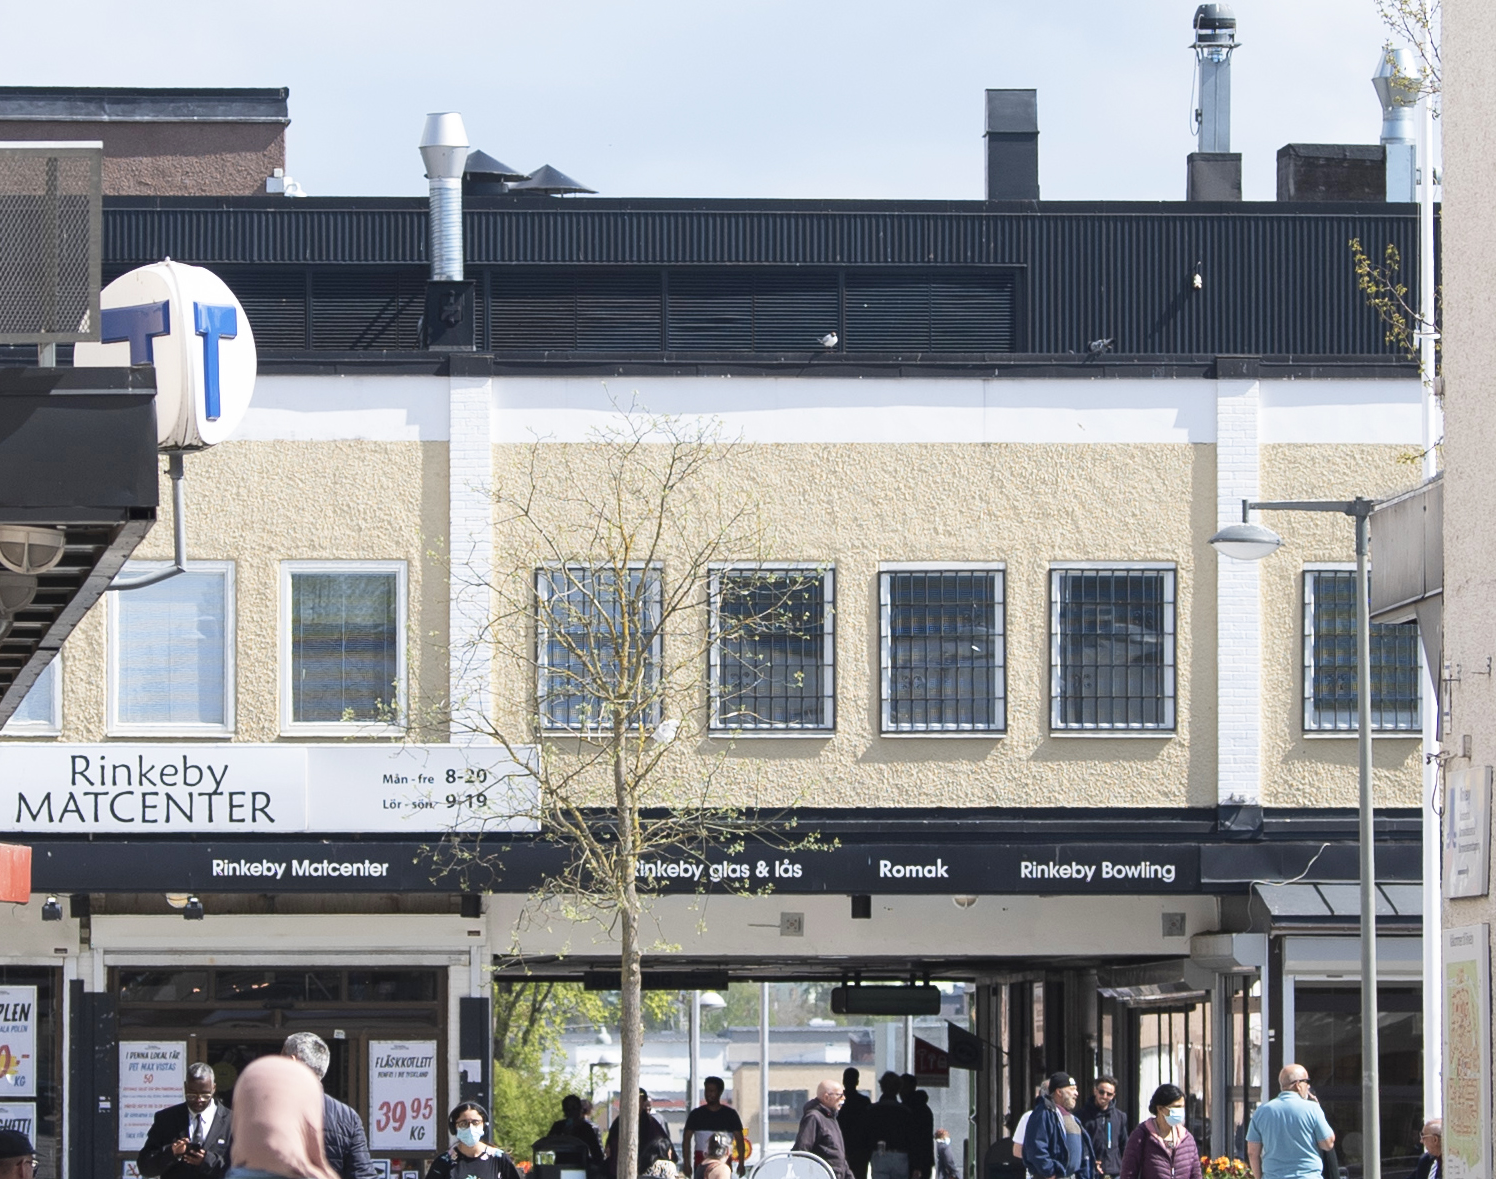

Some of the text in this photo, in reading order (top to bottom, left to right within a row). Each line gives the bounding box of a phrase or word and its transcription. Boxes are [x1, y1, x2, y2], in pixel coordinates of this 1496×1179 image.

[193, 301, 237, 422] T
[70, 754, 230, 797] Rinkeby
[383, 773, 408, 784] Mån
[418, 773, 434, 784] fre
[445, 768, 487, 784] 8-20
[15, 791, 276, 824] MATCENTER
[383, 799, 402, 809] Lör
[412, 799, 433, 809] sön
[212, 859, 389, 879] Rinkeby Matcenter
[634, 858, 802, 882] Rinkeby glas & lås
[879, 858, 949, 878] Romak
[1020, 861, 1176, 883] Rinkeby Bowling
[140, 1063, 155, 1072] MAX
[14, 1076, 26, 1087] KG
[143, 1074, 154, 1084] 50
[376, 1097, 433, 1133] 39 95
[410, 1126, 426, 1141] KG
